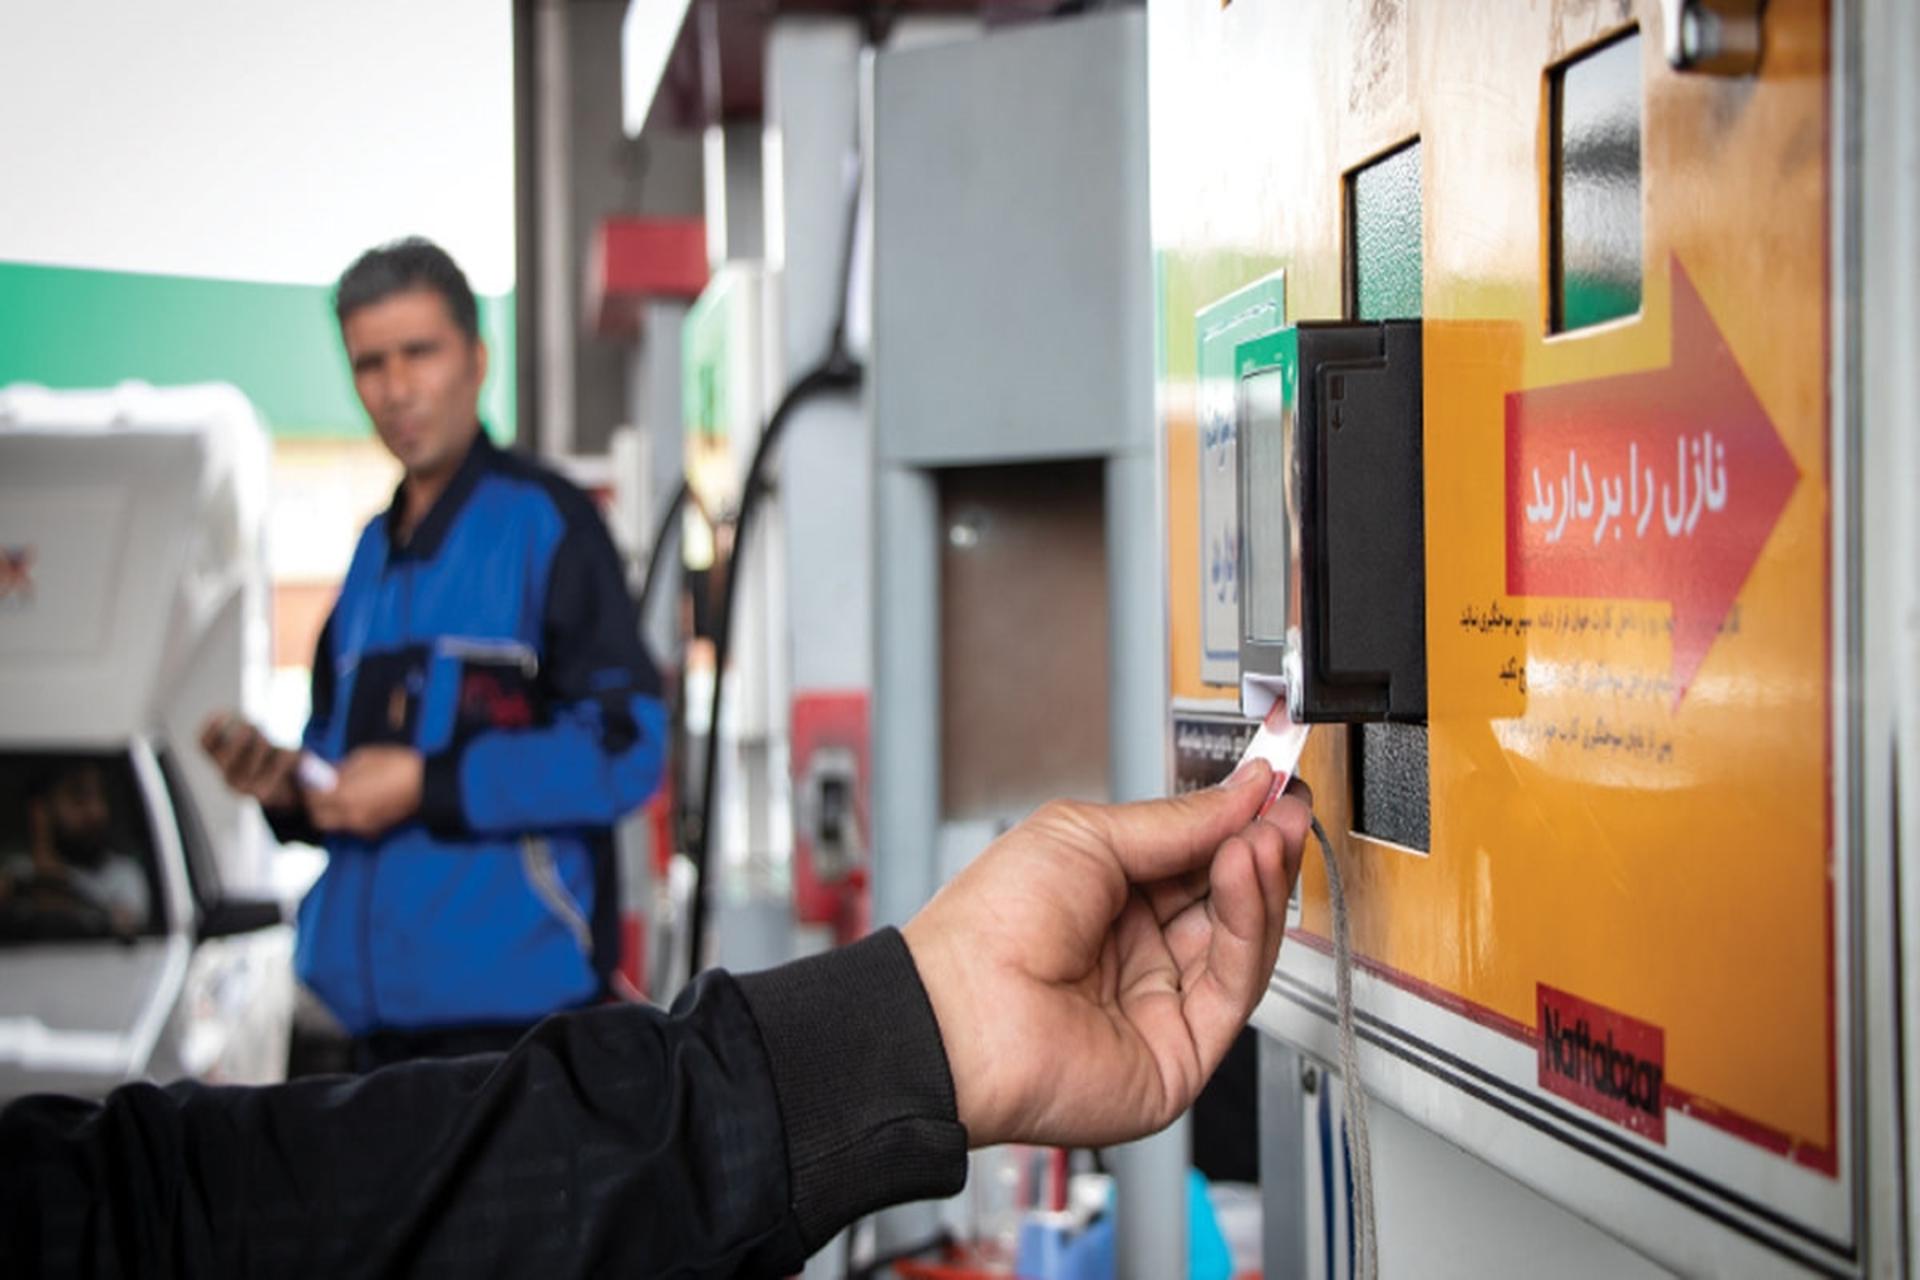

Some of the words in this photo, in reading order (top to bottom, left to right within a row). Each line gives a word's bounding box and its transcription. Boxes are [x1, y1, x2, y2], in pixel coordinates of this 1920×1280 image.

[1525, 447, 1624, 545] بردارید
[1629, 440, 1655, 539] را
[1661, 430, 1729, 539] نازل
